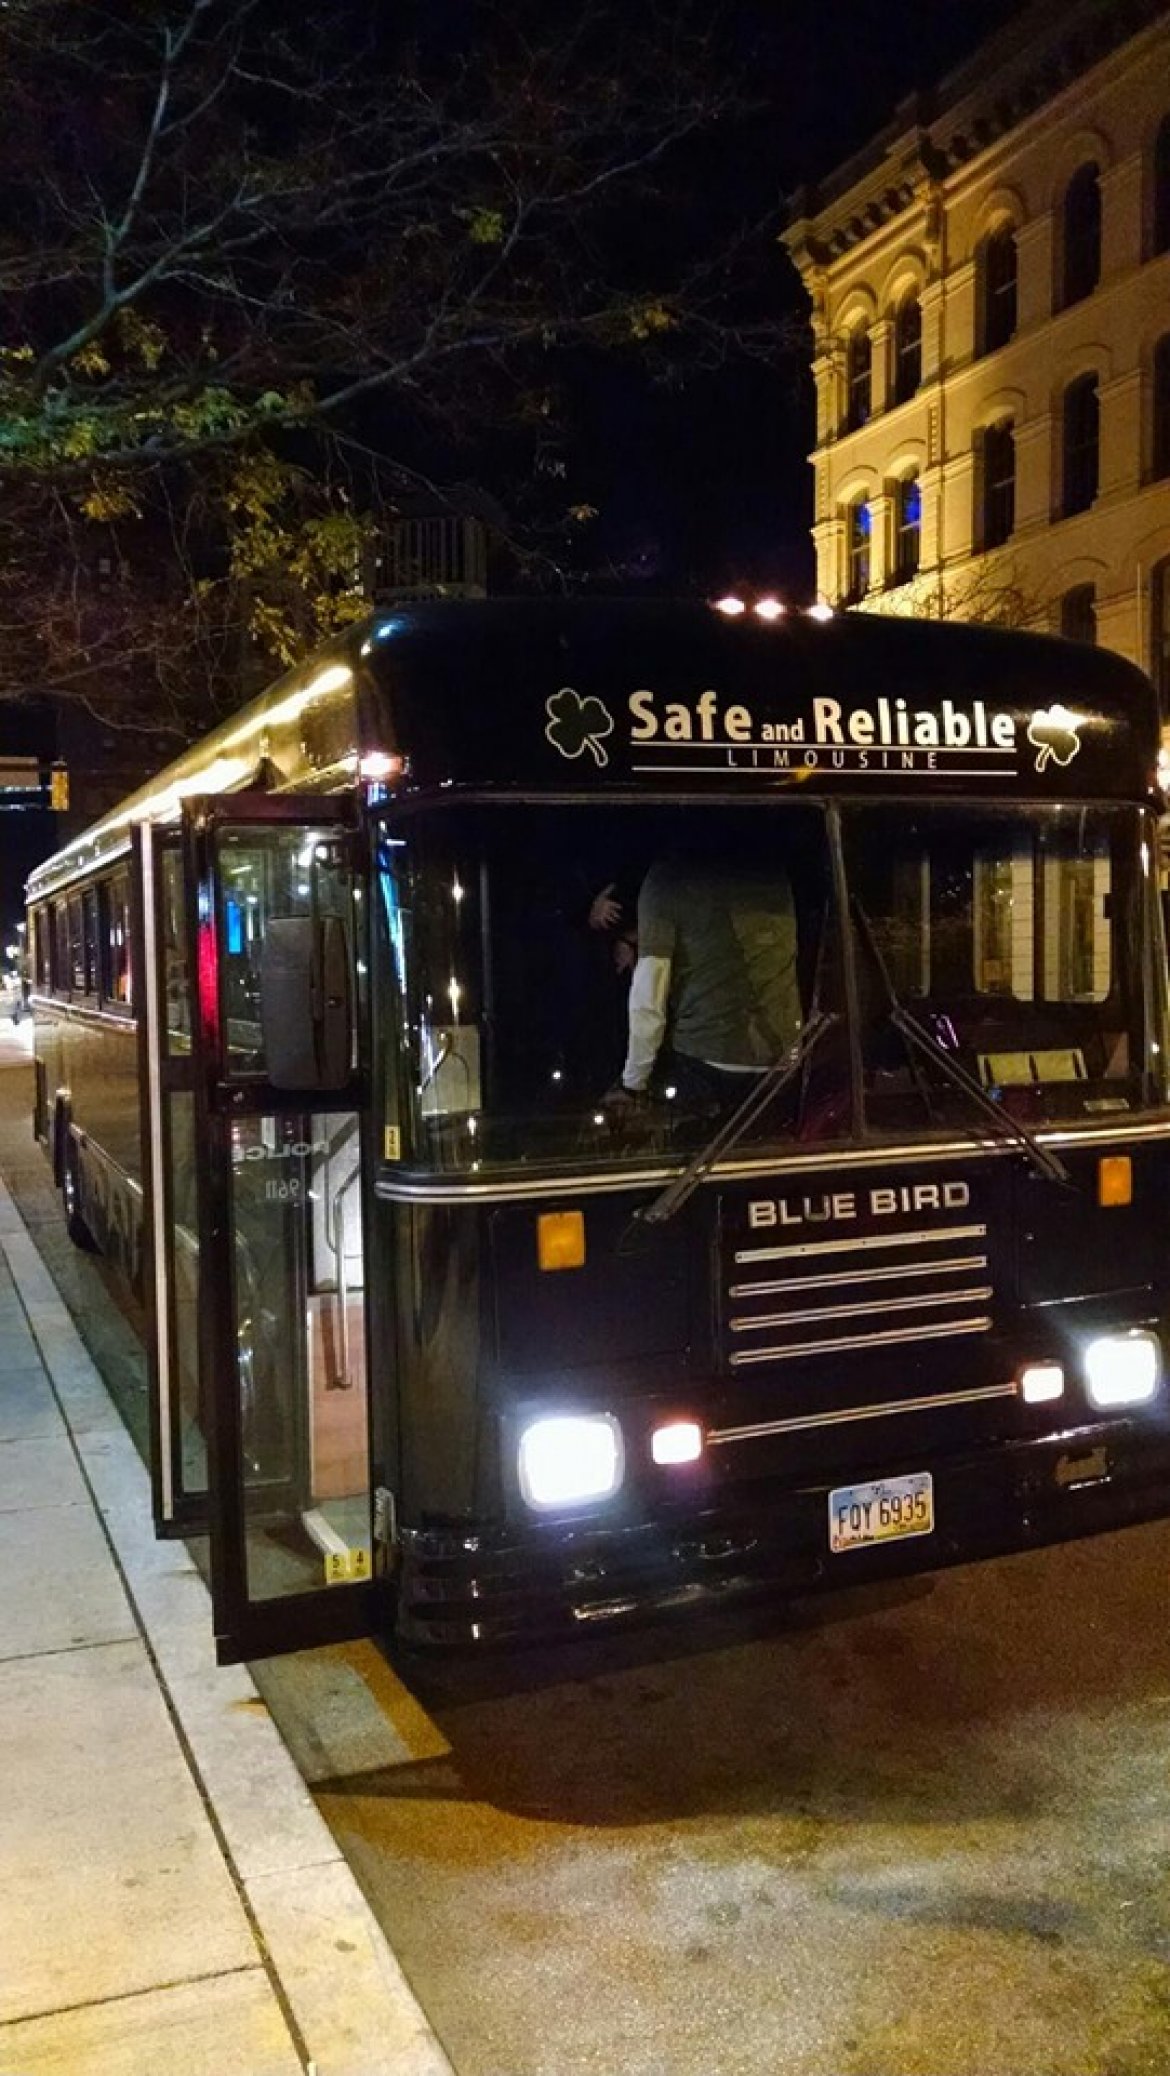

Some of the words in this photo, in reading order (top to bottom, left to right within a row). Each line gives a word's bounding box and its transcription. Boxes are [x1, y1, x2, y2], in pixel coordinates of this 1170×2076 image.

[628, 689, 752, 741] Safe
[761, 717, 805, 742] and
[812, 696, 1016, 747] Reliable
[727, 748, 938, 769] LIMOUSINE
[748, 1193, 858, 1229] BLUE
[870, 1181, 970, 1215] BIRD
[879, 1491, 927, 1526] 6935
